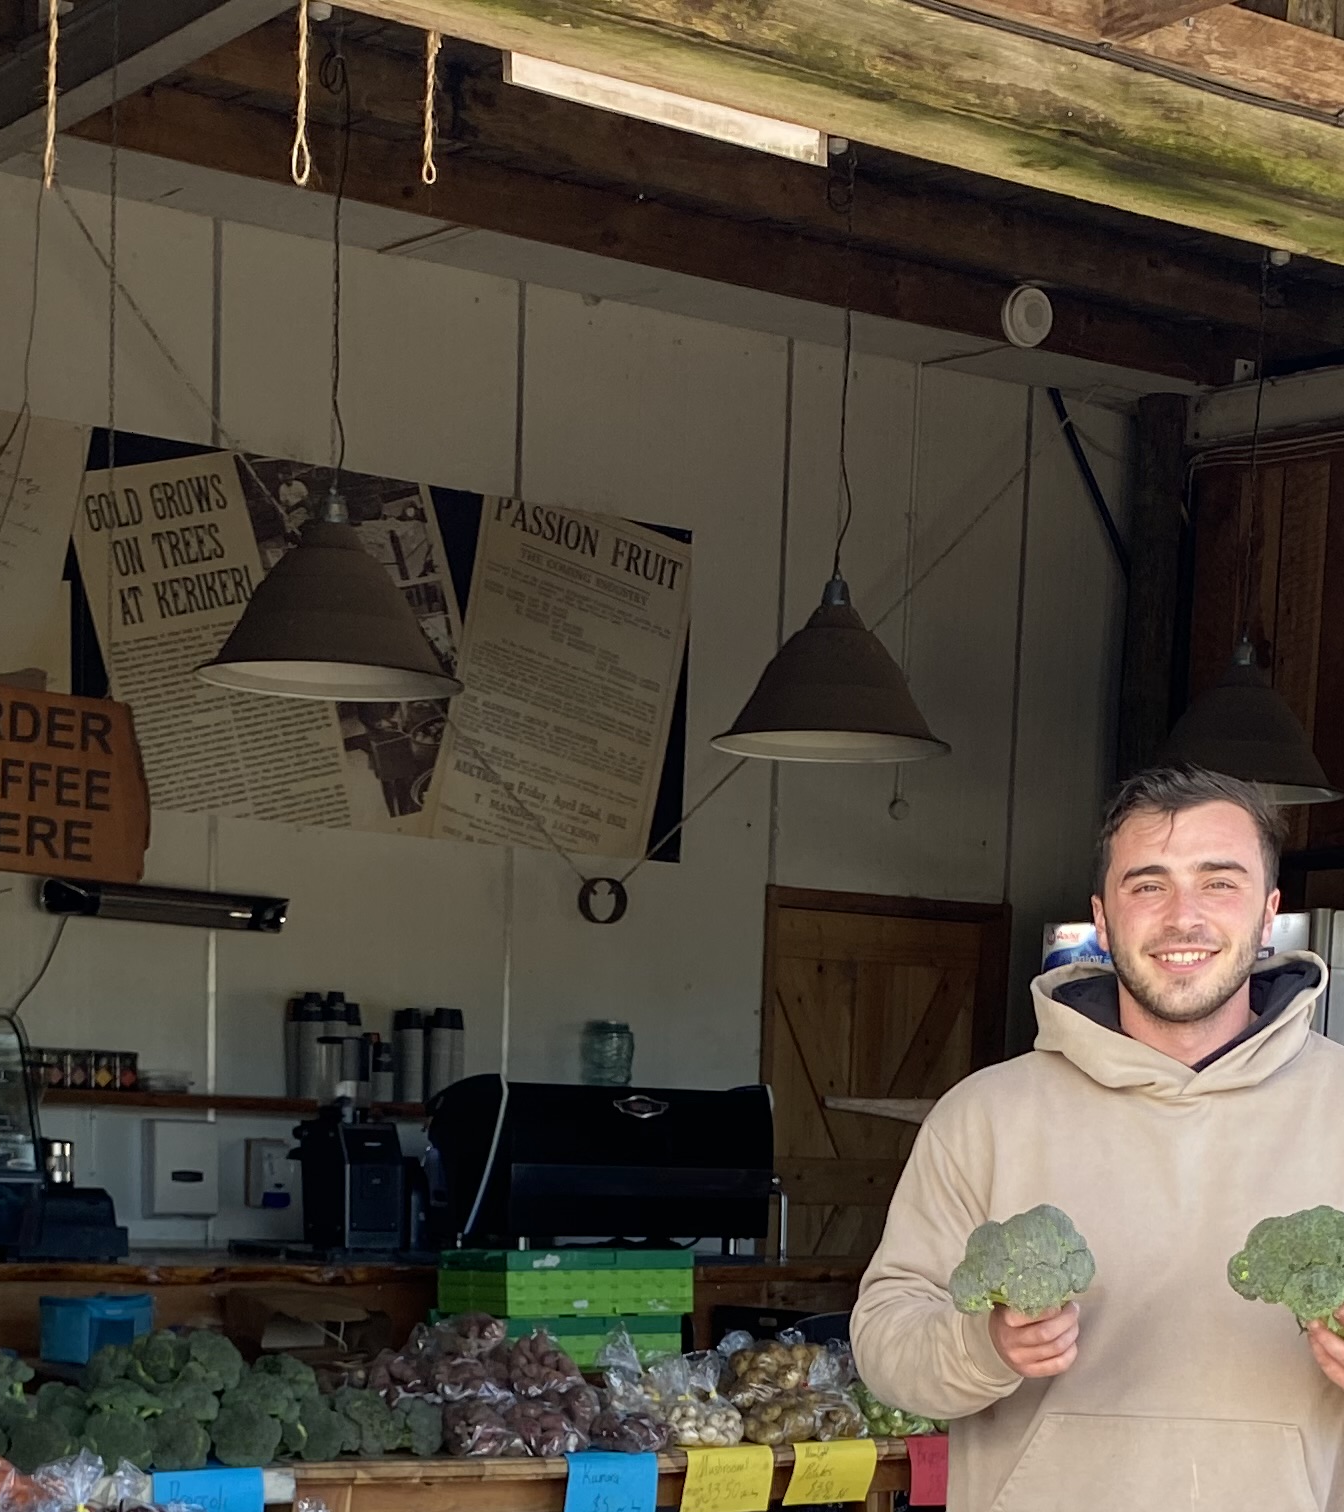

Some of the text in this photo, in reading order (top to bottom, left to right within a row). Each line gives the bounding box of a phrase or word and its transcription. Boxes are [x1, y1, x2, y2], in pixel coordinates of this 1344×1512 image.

[85, 473, 227, 532] GOLD GROWS
[112, 522, 225, 577] ON TREES
[495, 497, 683, 590] PASSION FRUIT
[118, 564, 254, 626] AT KERIKERI
[519, 549, 650, 608] THE COMING INDUSTRY
[553, 794, 577, 812] April
